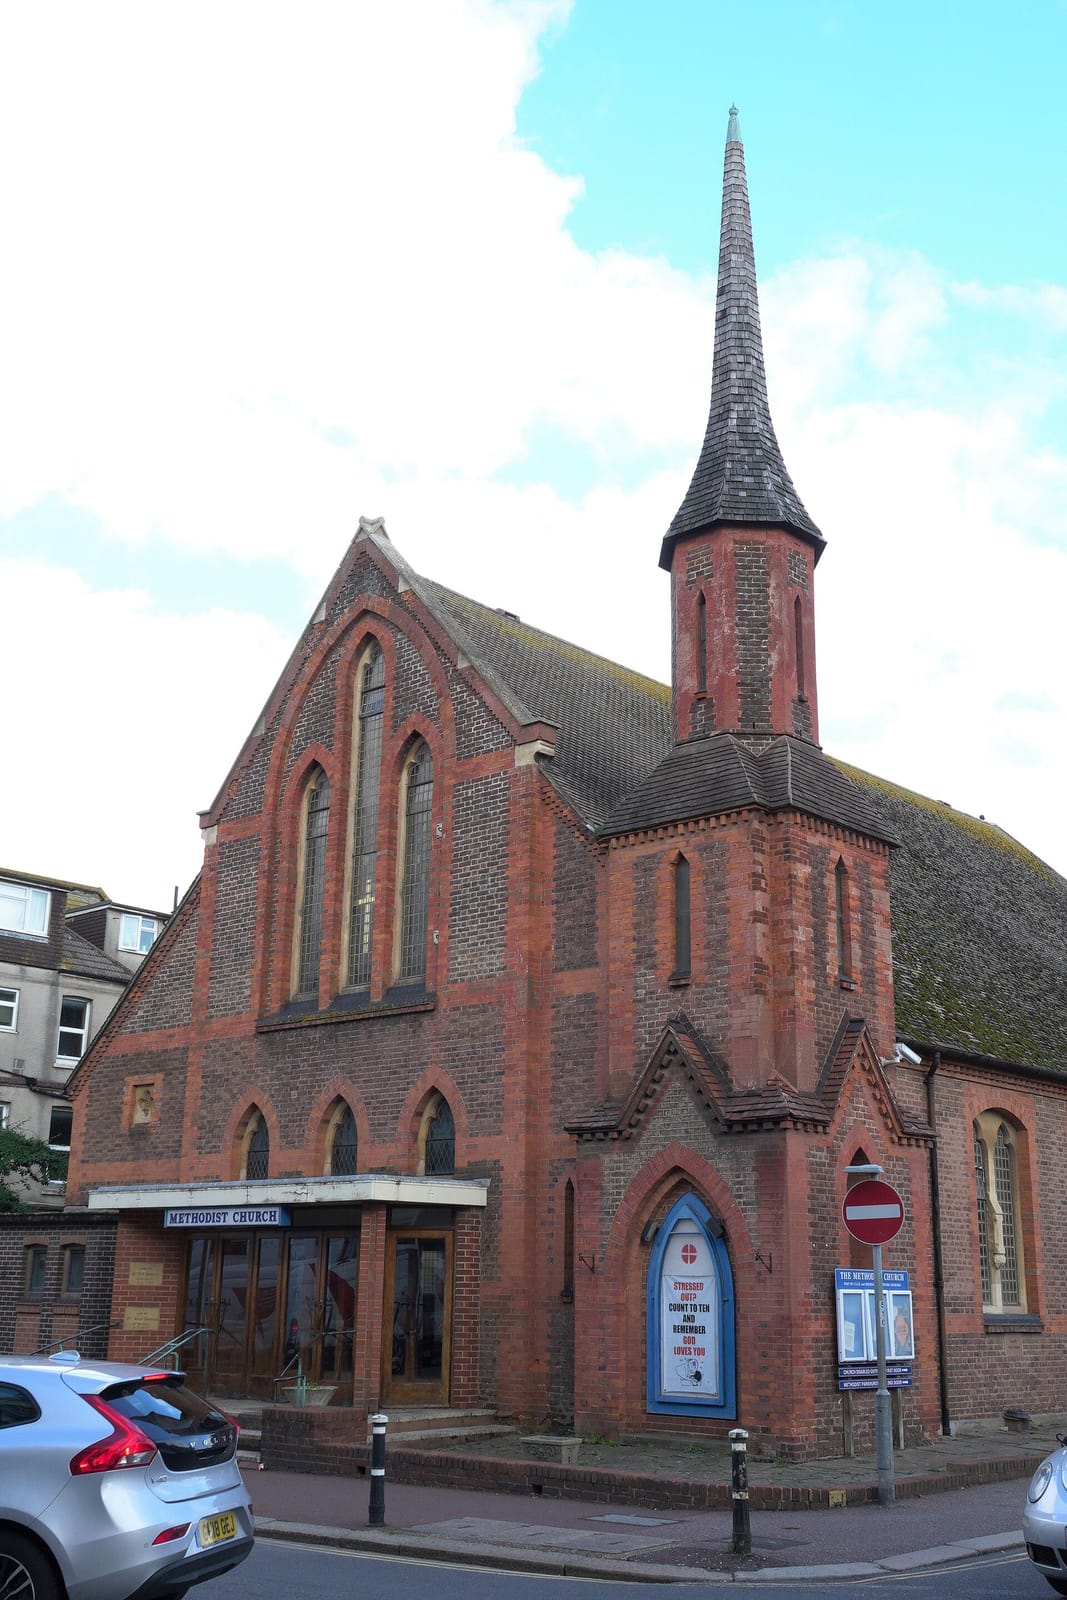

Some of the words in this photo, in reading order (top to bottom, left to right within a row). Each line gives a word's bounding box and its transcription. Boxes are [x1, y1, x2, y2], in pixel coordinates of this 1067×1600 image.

[169, 1212, 228, 1224] METHODIST
[232, 1210, 277, 1223] CHURCH
[840, 1271, 852, 1280] THE
[883, 1273, 904, 1281] CHURCH
[673, 1282, 704, 1291] STRESSED
[680, 1293, 697, 1302] OUT?
[668, 1303, 689, 1312] COUNT
[690, 1303, 698, 1313] TO
[699, 1303, 710, 1313] TEN
[682, 1314, 696, 1323] AND
[672, 1324, 706, 1334] REMEMBER
[682, 1335, 696, 1345] GOD
[673, 1346, 692, 1356] LOVES
[693, 1347, 706, 1357] YOU
